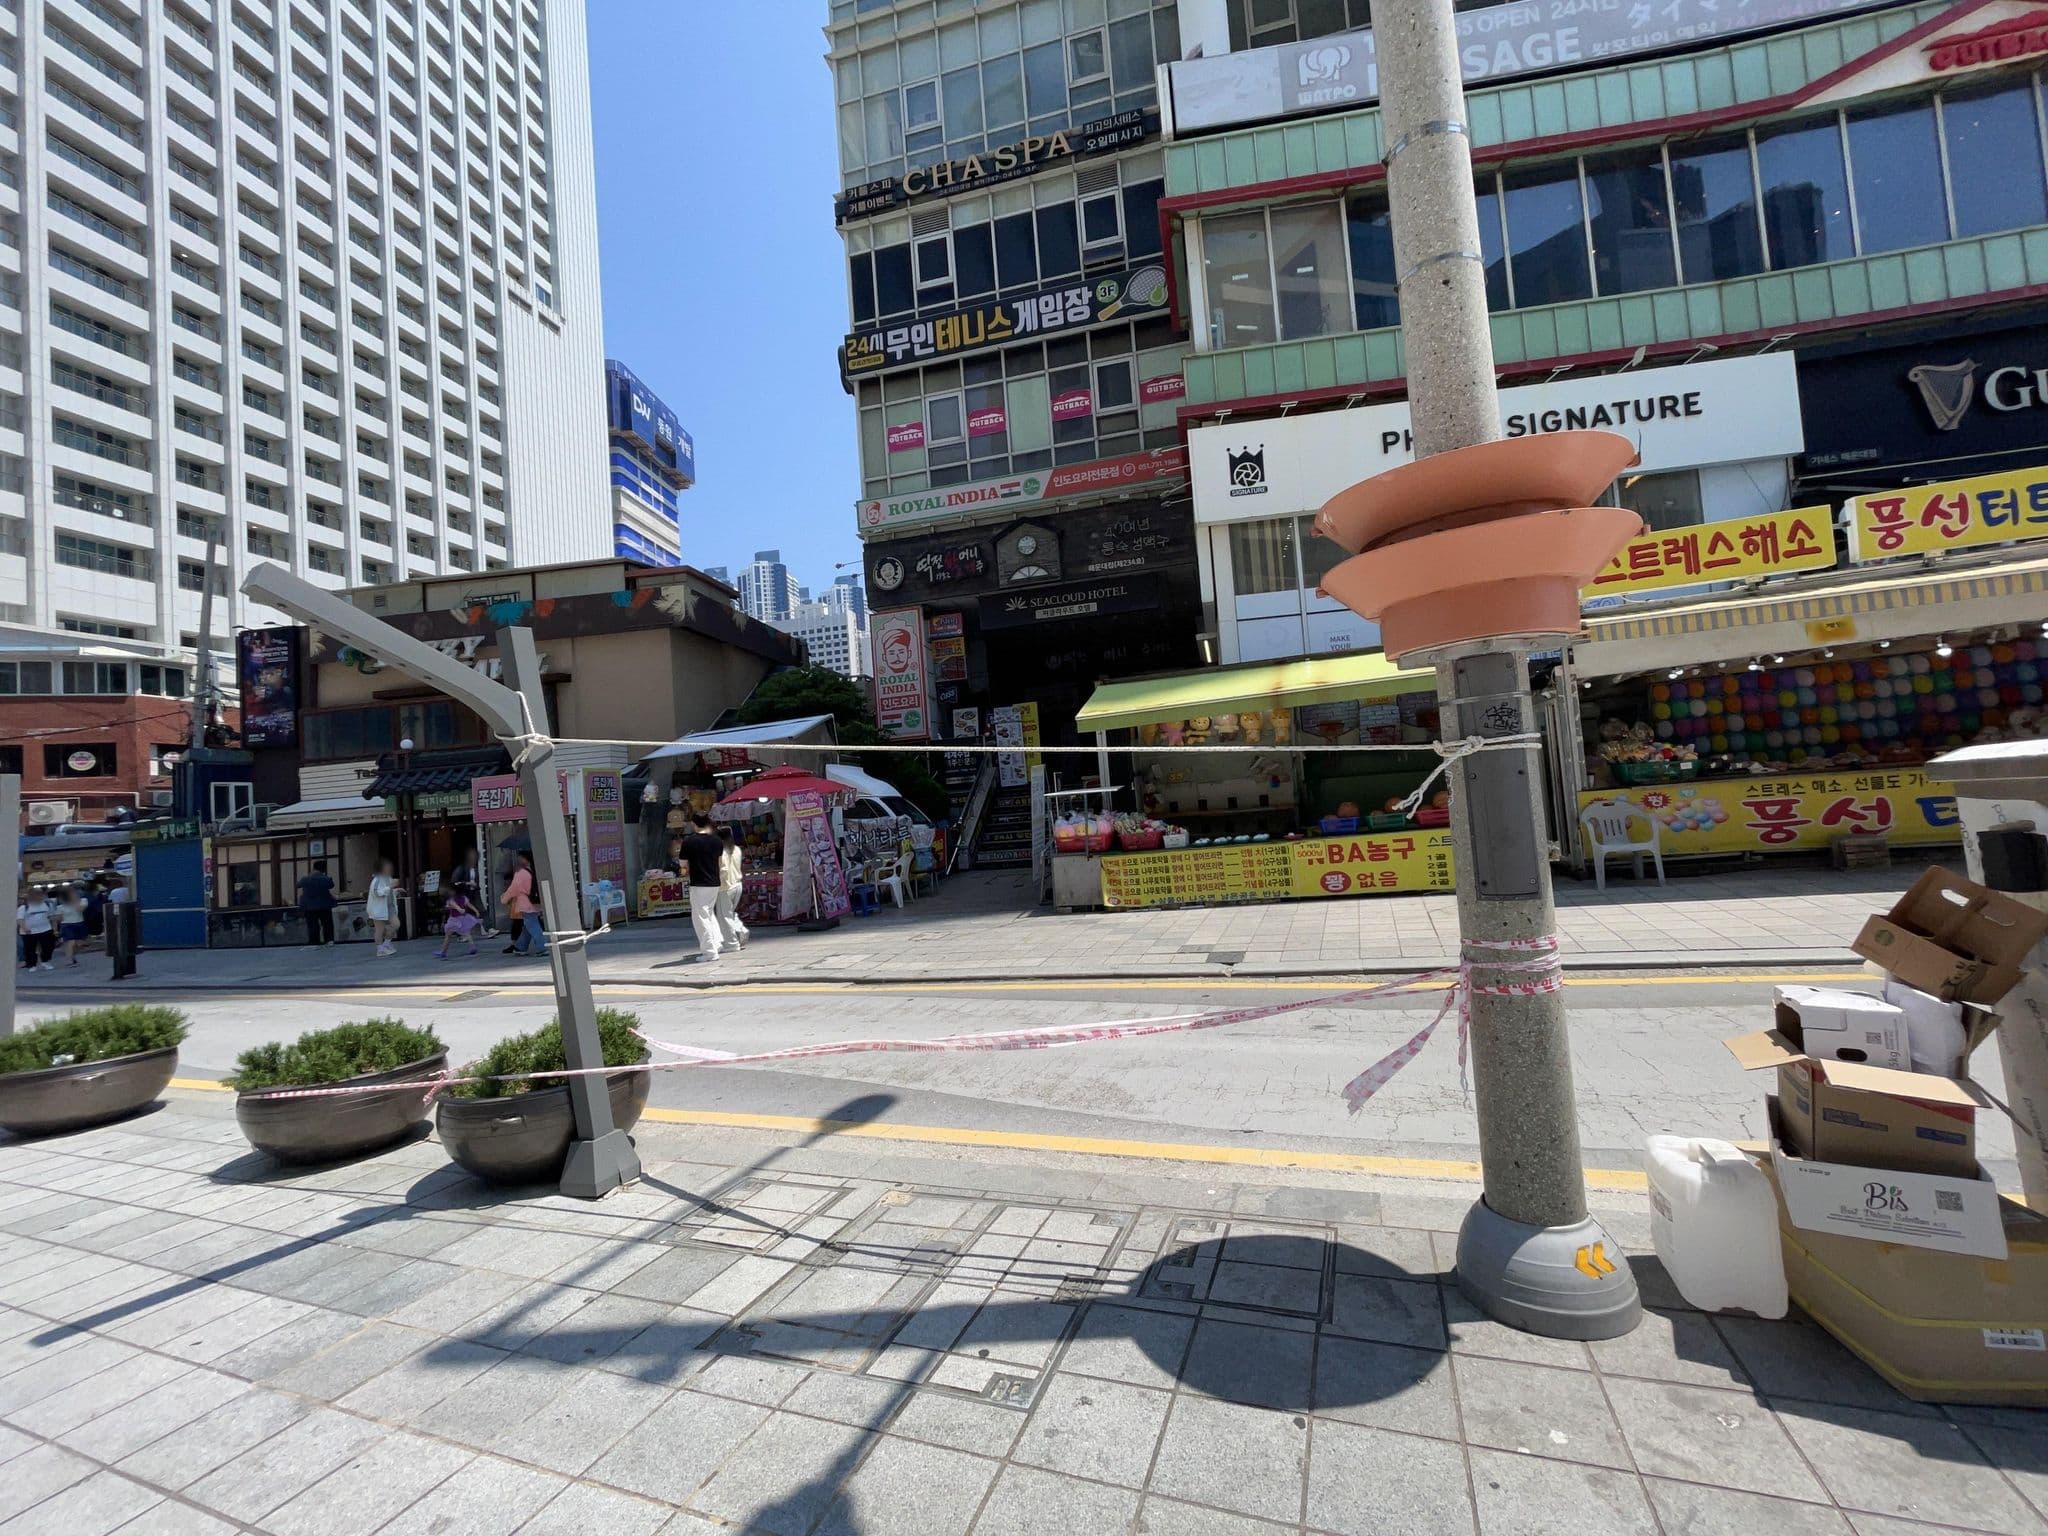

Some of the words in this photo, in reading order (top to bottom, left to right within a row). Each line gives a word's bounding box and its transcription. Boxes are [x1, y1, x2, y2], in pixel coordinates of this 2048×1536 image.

[1476, 6, 1541, 33] OPEN
[1461, 26, 1582, 80] SAGE
[903, 154, 987, 196] CHA
[995, 130, 1073, 171] SPA
[1100, 285, 1116, 298] 3F
[847, 332, 884, 357] 24시
[1147, 380, 1185, 394] OUTBACK
[1053, 399, 1091, 413] OUTBACK
[1507, 391, 1704, 438] SIGNATURE
[969, 416, 1006, 428] OUTBACK
[888, 431, 924, 444] OUTBACK
[1052, 465, 1120, 488] 인도요리전문점
[887, 496, 945, 517] ROYAL
[946, 486, 1001, 506] INDIA
[1031, 591, 1086, 608] SEACLOUD
[1088, 585, 1128, 600] HOTEL
[880, 673, 919, 686] ROYAL
[882, 682, 917, 695] INDIA
[1746, 781, 1807, 798] 스트레스
[1854, 774, 1902, 792] 선물도
[1308, 837, 1416, 865] BA농구
[1356, 870, 1399, 889] 없음
